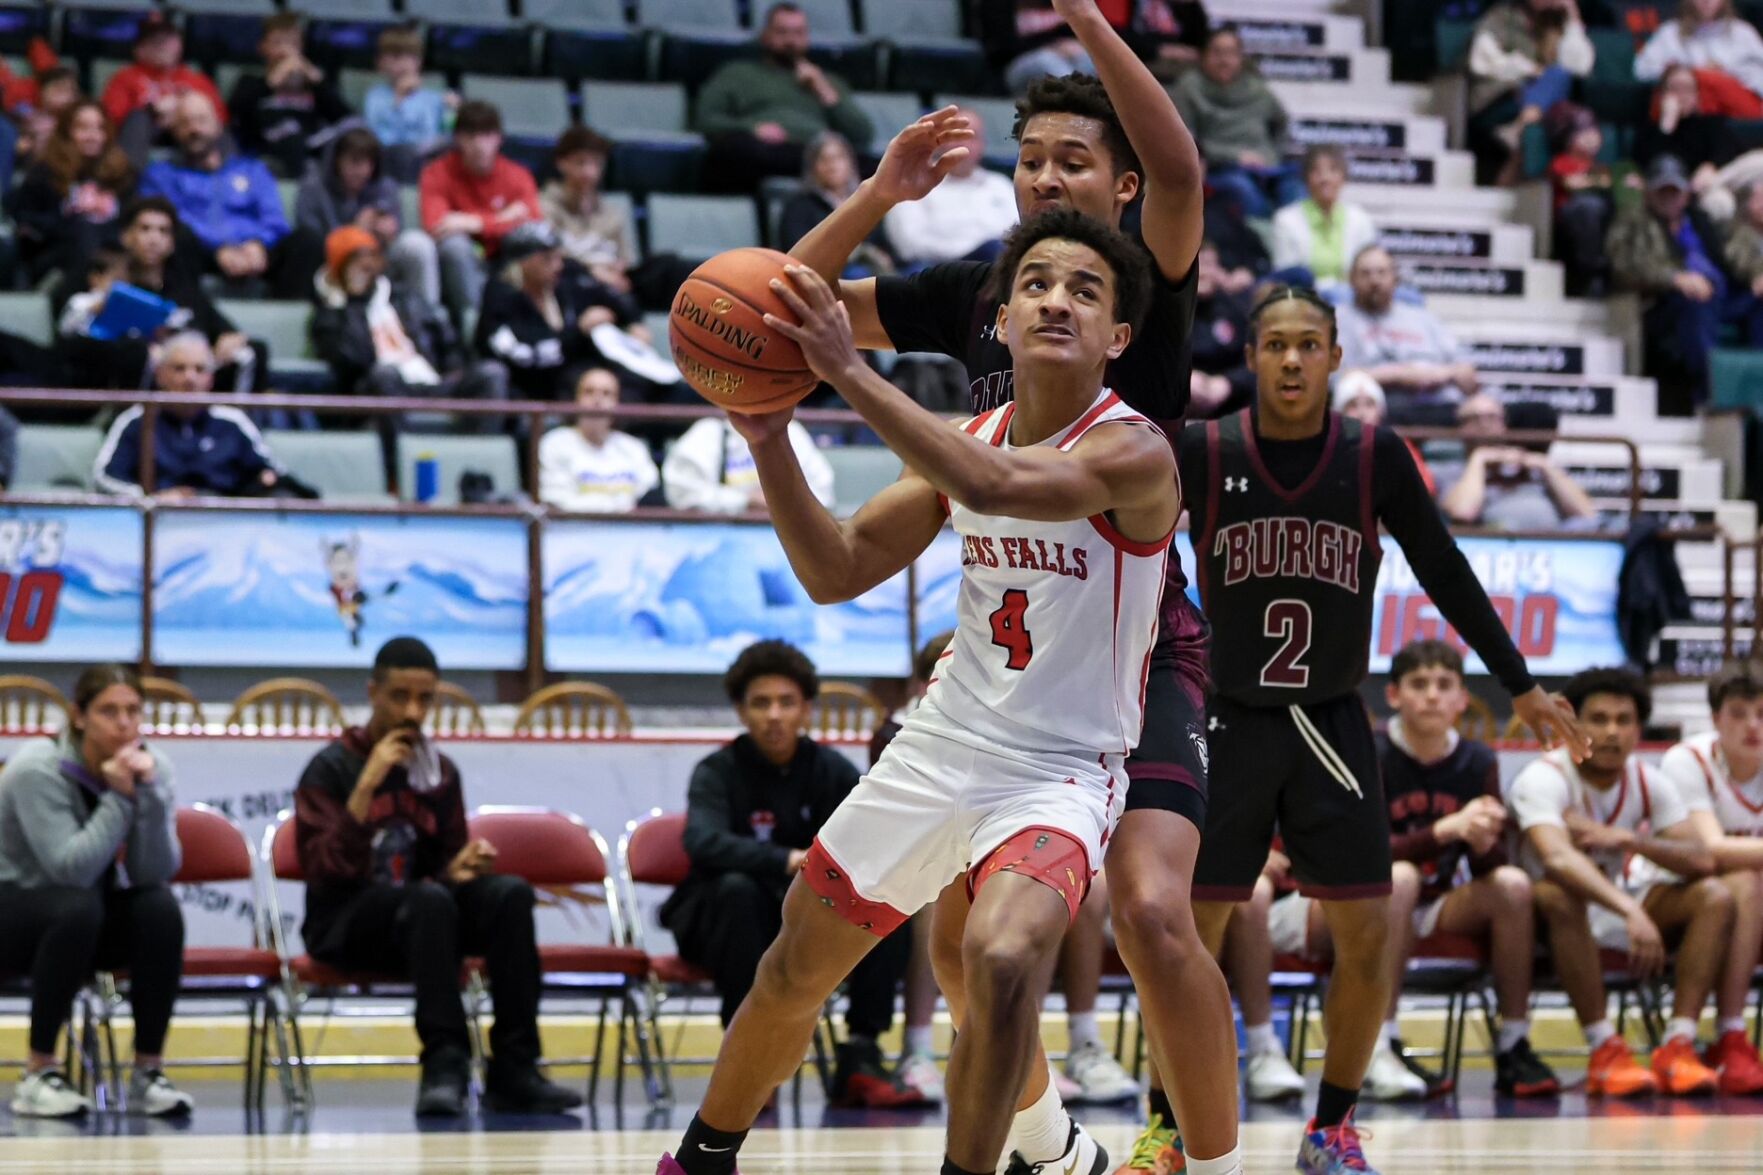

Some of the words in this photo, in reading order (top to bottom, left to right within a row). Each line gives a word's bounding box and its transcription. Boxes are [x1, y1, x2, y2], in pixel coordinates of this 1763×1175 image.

[675, 291, 769, 360] SPALDING
[1000, 537, 1088, 581] FALLS
[989, 588, 1034, 671] 4
[1260, 599, 1312, 688] 2
